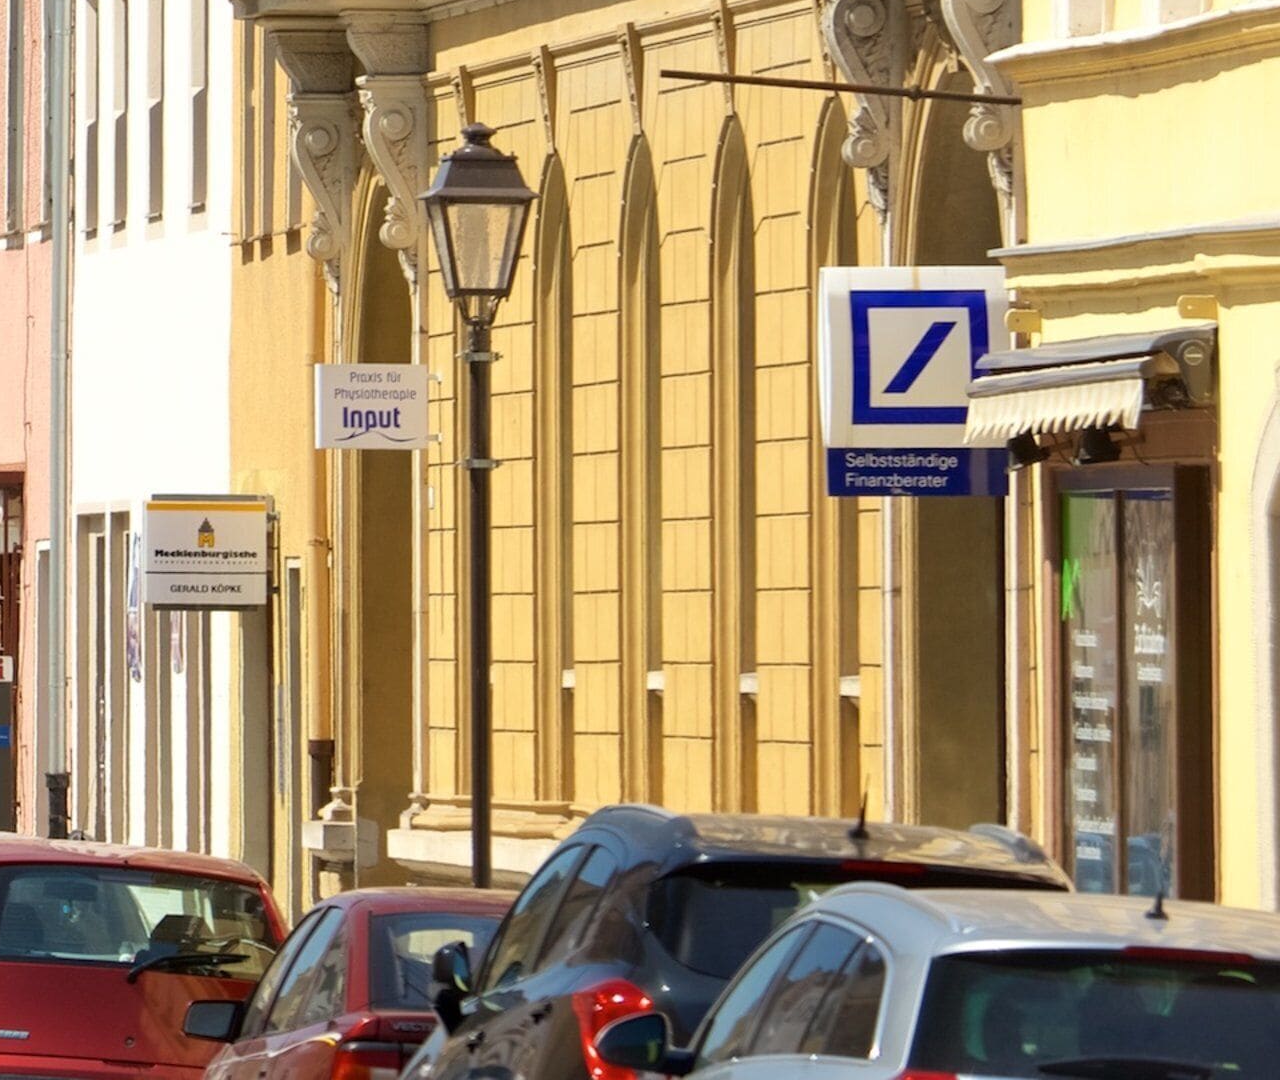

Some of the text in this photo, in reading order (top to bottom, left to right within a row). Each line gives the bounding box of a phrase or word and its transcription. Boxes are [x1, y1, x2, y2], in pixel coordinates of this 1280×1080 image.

[350, 372, 402, 383] Praxis für
[334, 388, 417, 401] Physiotherapie
[343, 407, 400, 432] Input
[845, 452, 958, 470] Selbstständige
[845, 473, 949, 487] Finanzberater
[155, 549, 258, 560] Mecklenburgische
[170, 583, 242, 593] GERALD KÖPKE
